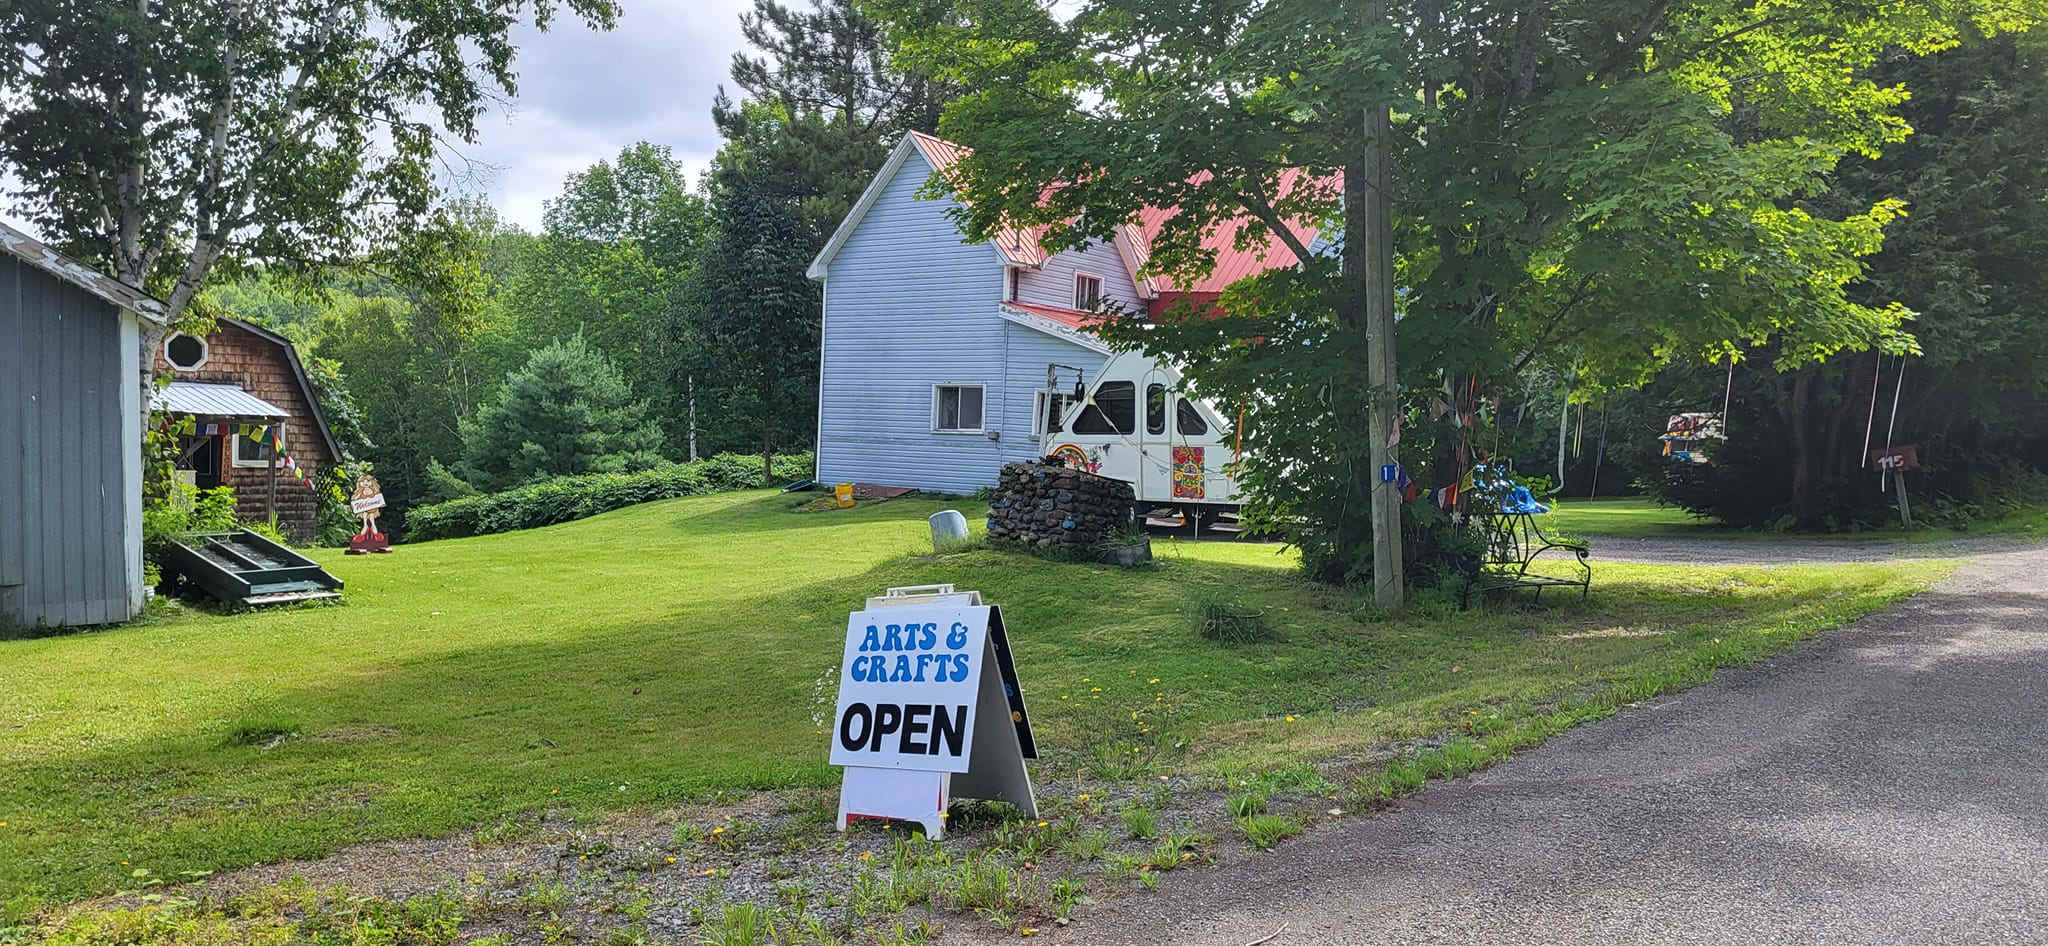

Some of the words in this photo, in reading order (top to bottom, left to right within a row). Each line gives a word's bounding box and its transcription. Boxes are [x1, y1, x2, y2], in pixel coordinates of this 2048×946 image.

[1878, 455, 1904, 468] 115
[859, 623, 937, 651] ARTS
[946, 622, 968, 650] &
[851, 654, 969, 682] CRAFTS
[840, 702, 968, 757] OPEN
